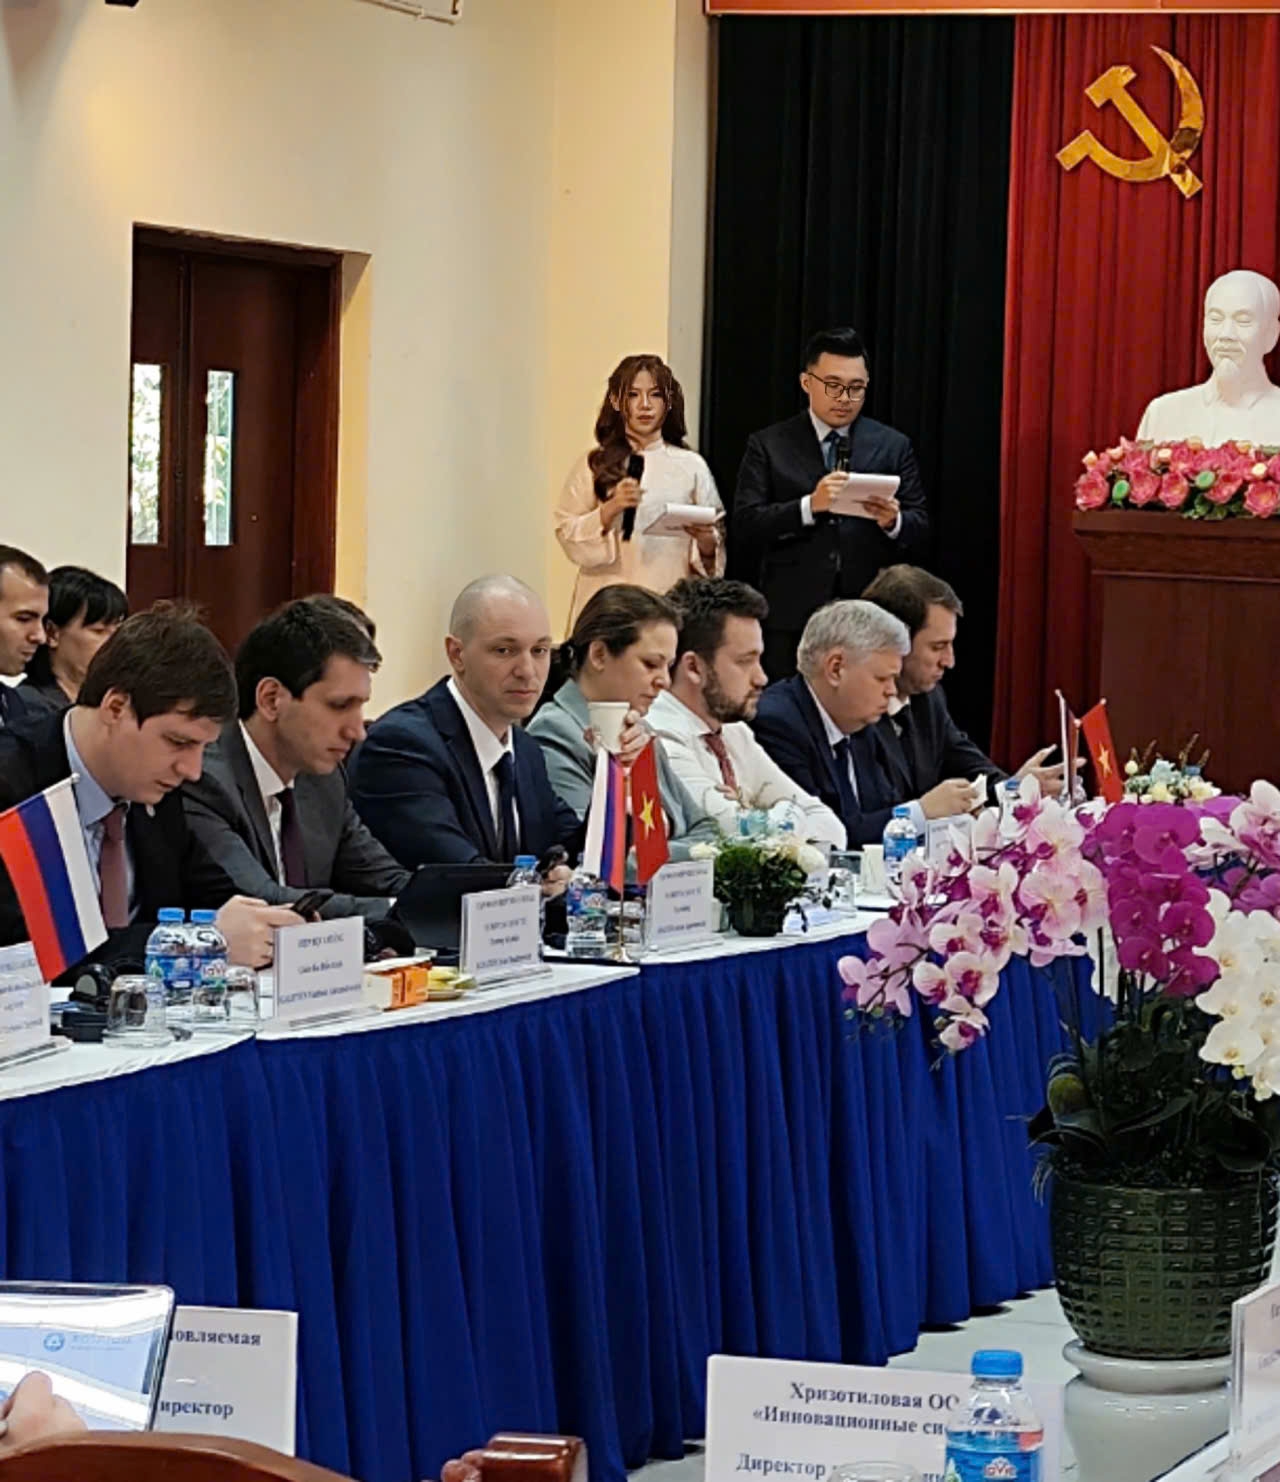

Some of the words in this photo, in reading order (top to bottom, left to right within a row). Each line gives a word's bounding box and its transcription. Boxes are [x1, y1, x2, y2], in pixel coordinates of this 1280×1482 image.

[175, 1329, 261, 1346] овляемая
[790, 1382, 923, 1409] Хризотиловая
[160, 1401, 234, 1420] иректор
[753, 1405, 918, 1434] «Инновационные
[923, 1422, 947, 1437] си
[735, 1452, 827, 1481] Директор
